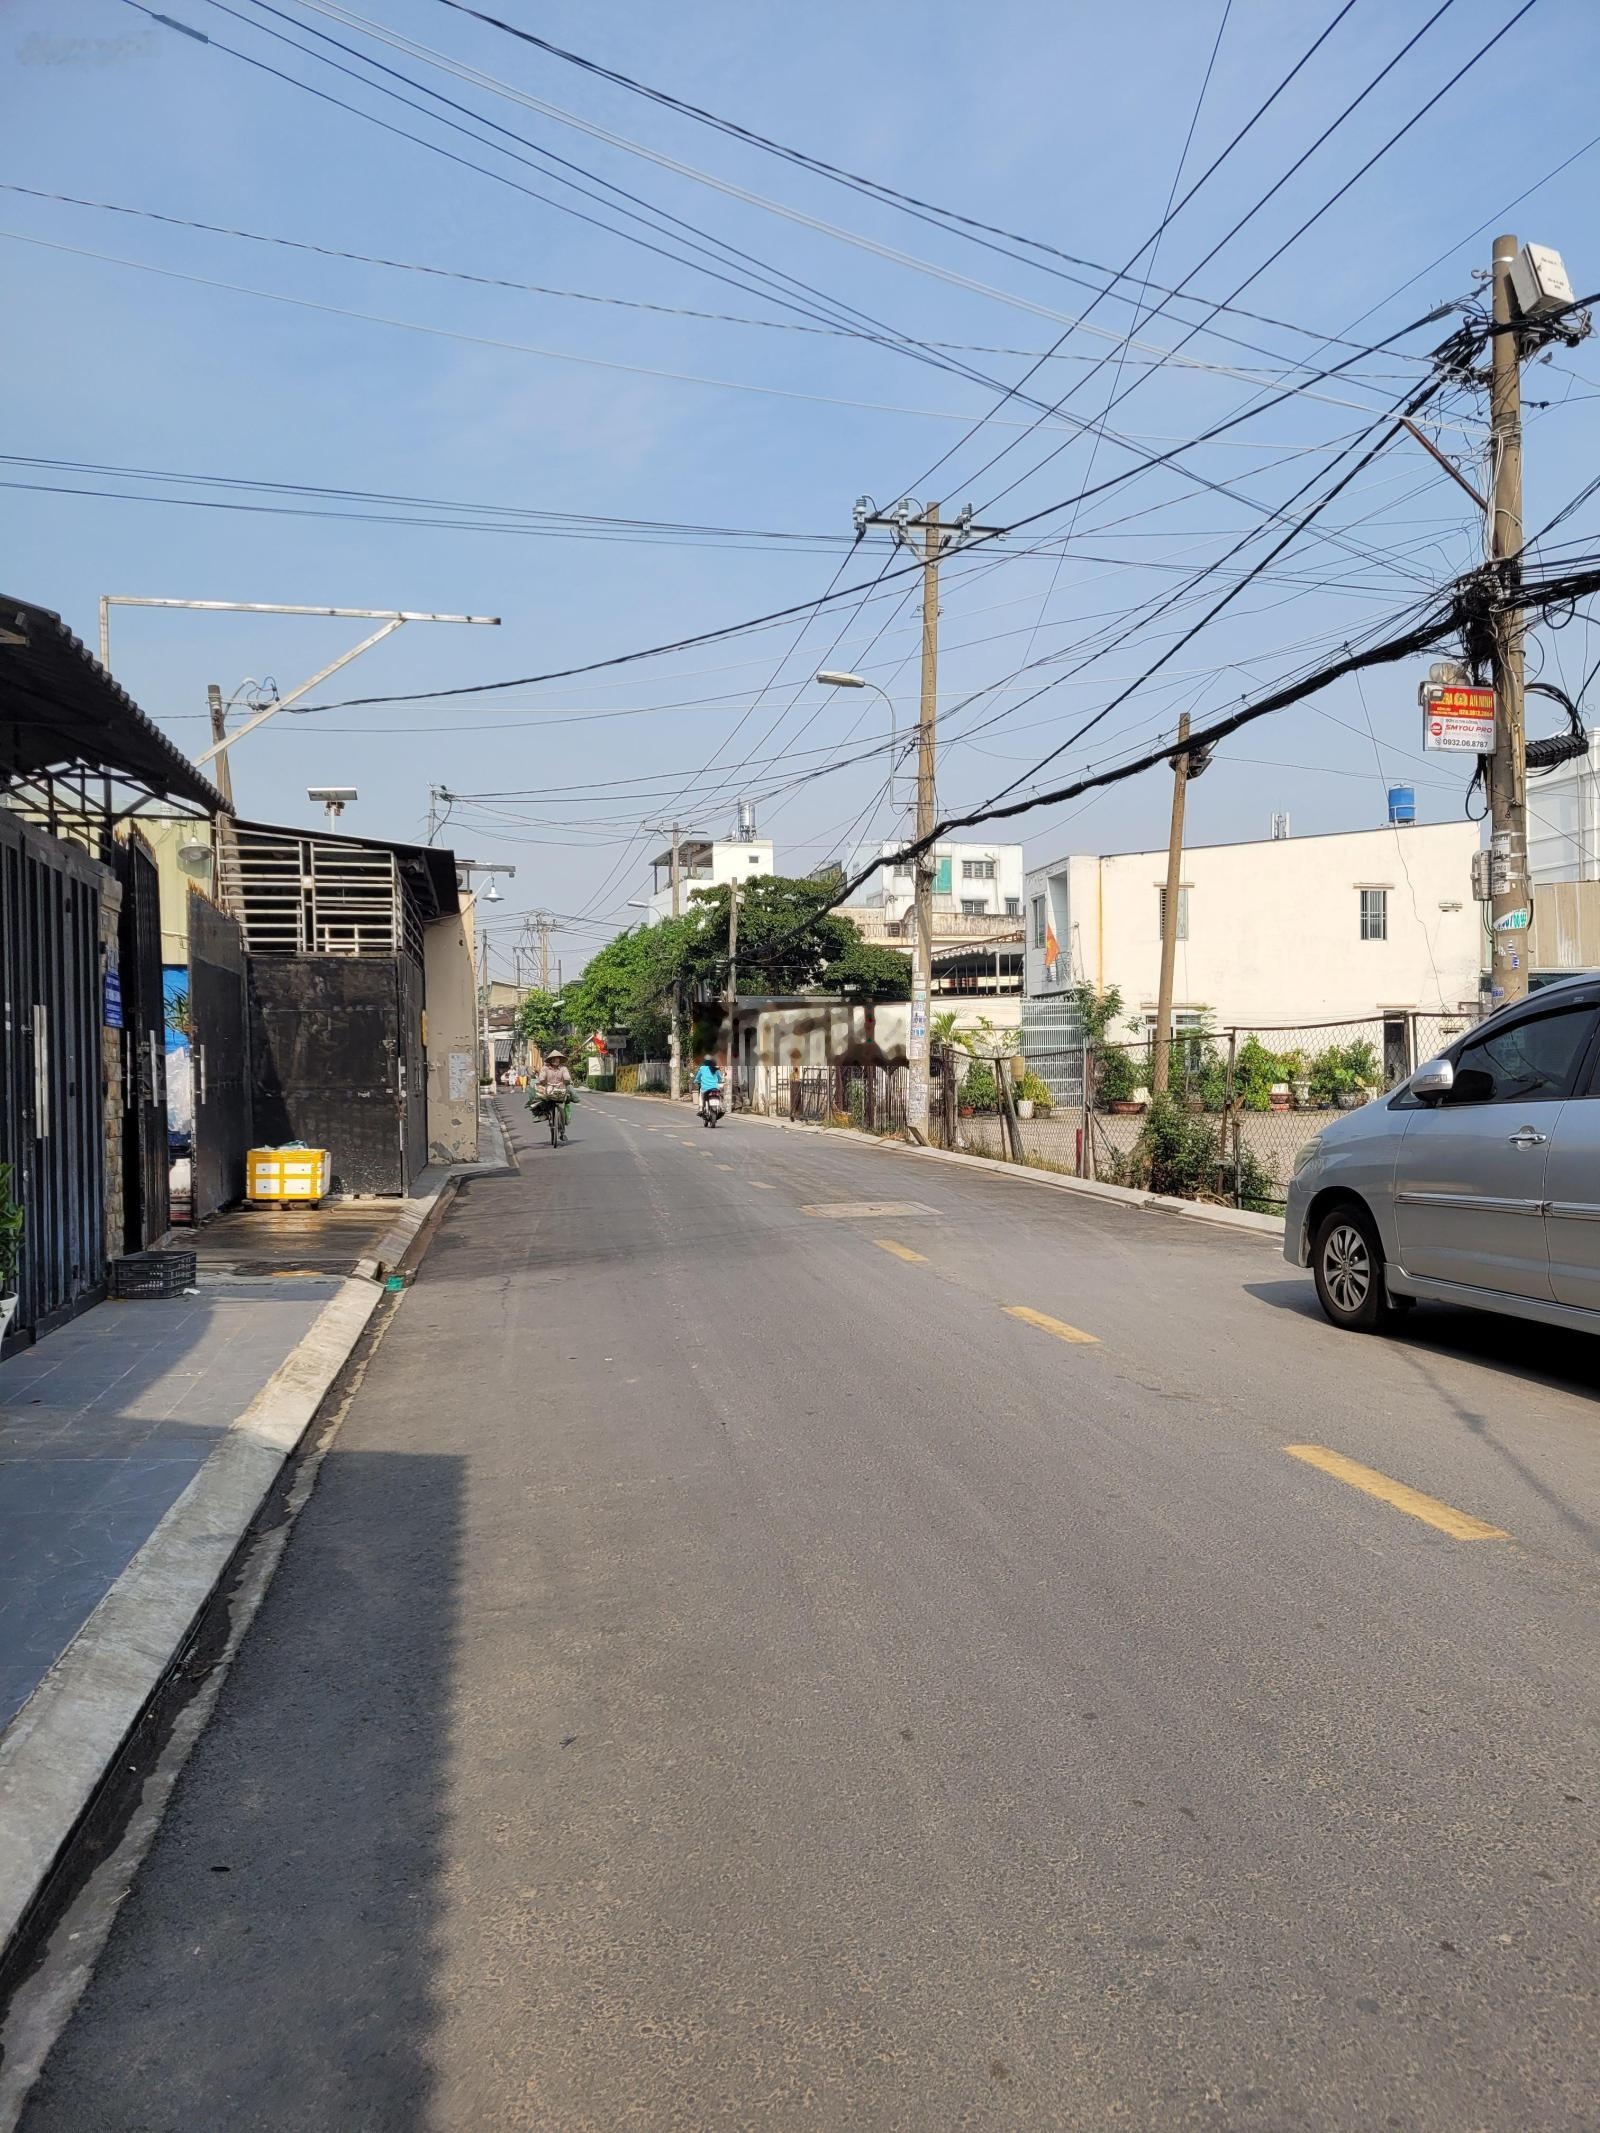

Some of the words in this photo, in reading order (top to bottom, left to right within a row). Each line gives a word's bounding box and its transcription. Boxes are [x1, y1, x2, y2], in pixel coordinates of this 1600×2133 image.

[1445, 724, 1475, 732] SMYOU
[1476, 726, 1493, 734] PRO
[1442, 738, 1488, 748] 0932.06.8787
